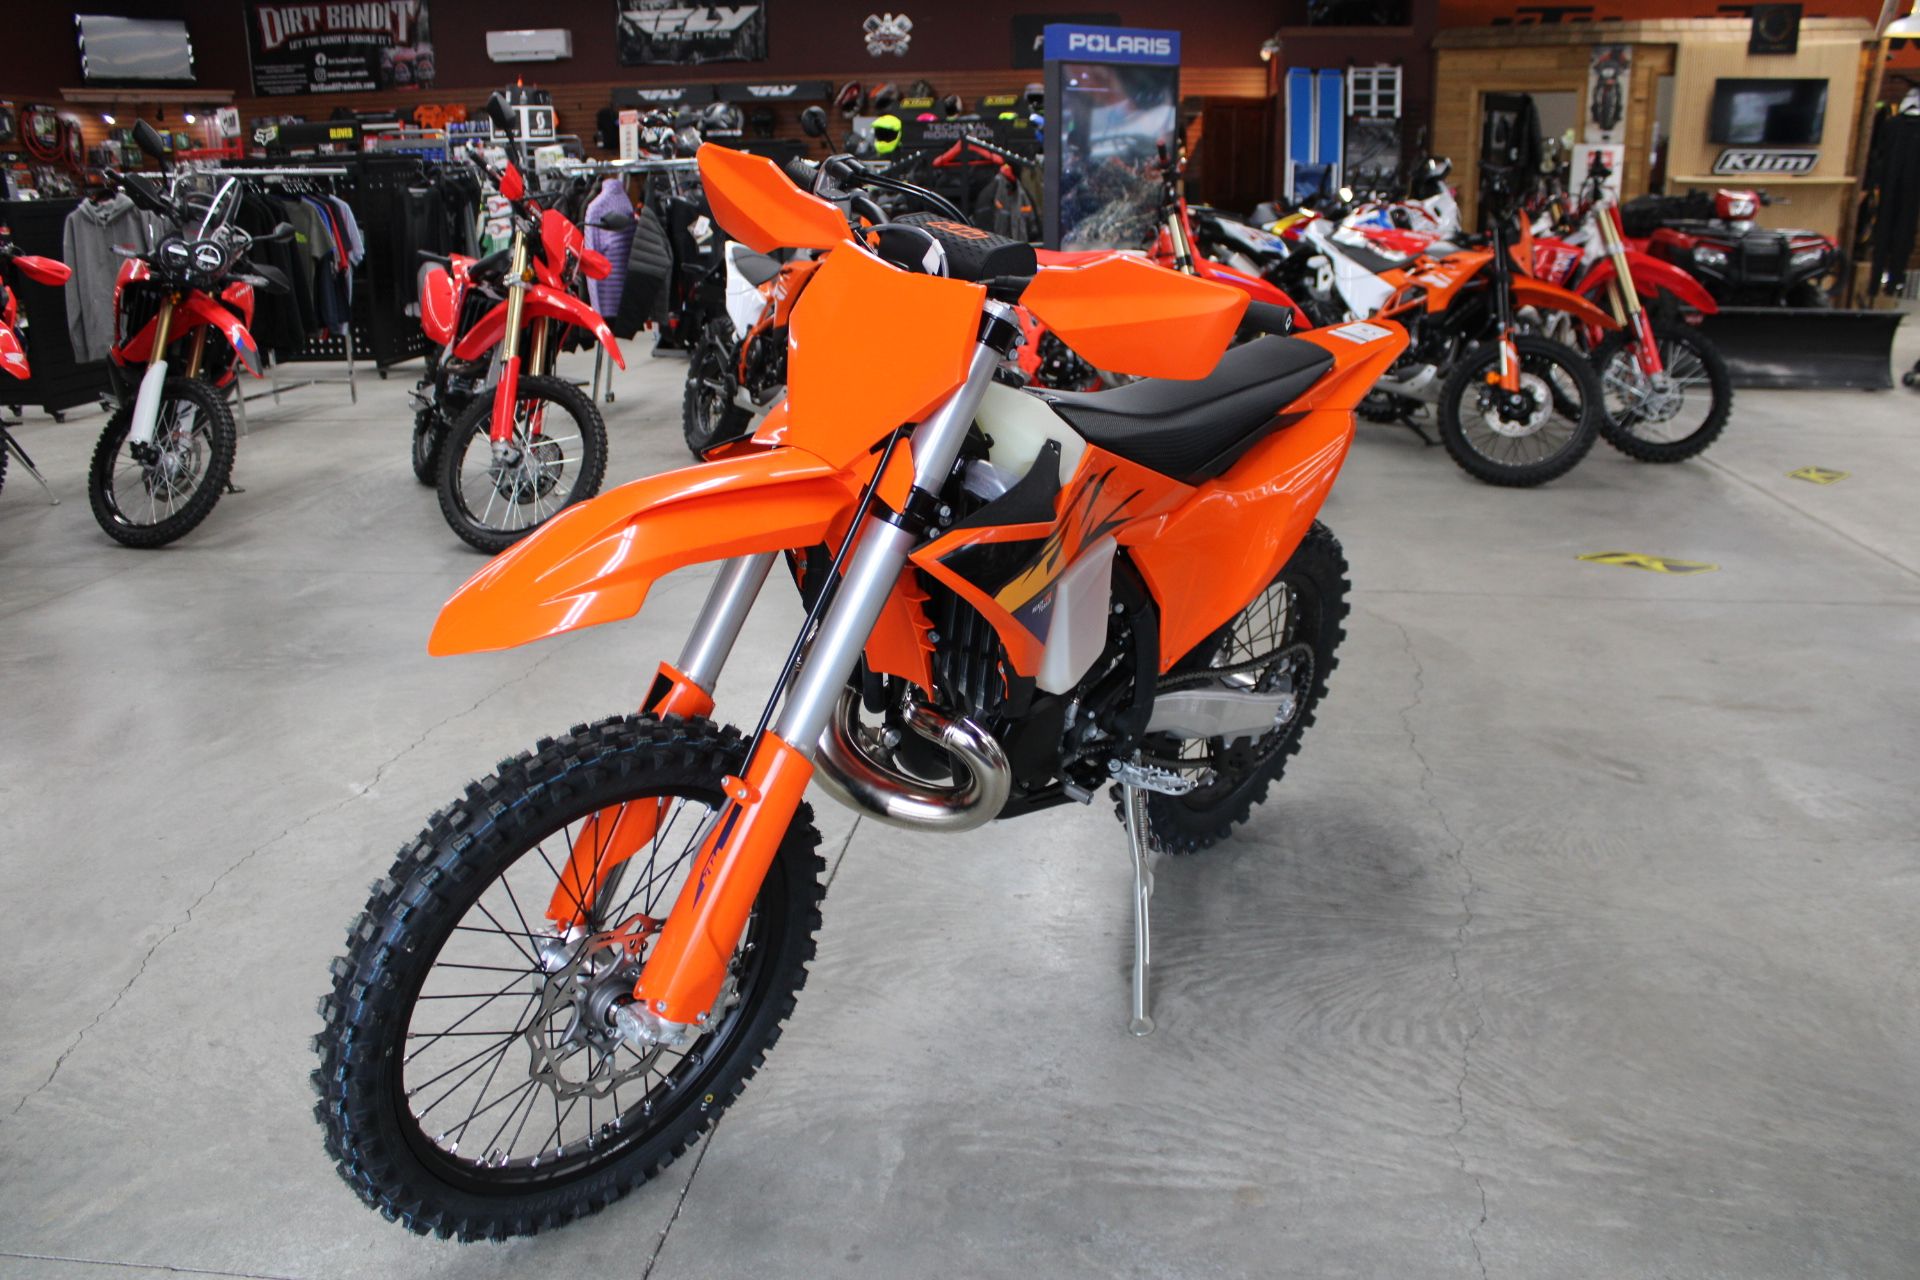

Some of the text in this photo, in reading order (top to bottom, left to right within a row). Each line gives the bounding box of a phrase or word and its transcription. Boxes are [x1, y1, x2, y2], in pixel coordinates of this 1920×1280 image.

[258, 1, 415, 49] DIRT BANDIT
[622, 5, 760, 34] FLY
[1068, 33, 1171, 56] POLARIS
[638, 88, 684, 100] FLY
[747, 85, 798, 97] FLY
[329, 127, 354, 140] GLOVES
[1724, 153, 1811, 171] Klim
